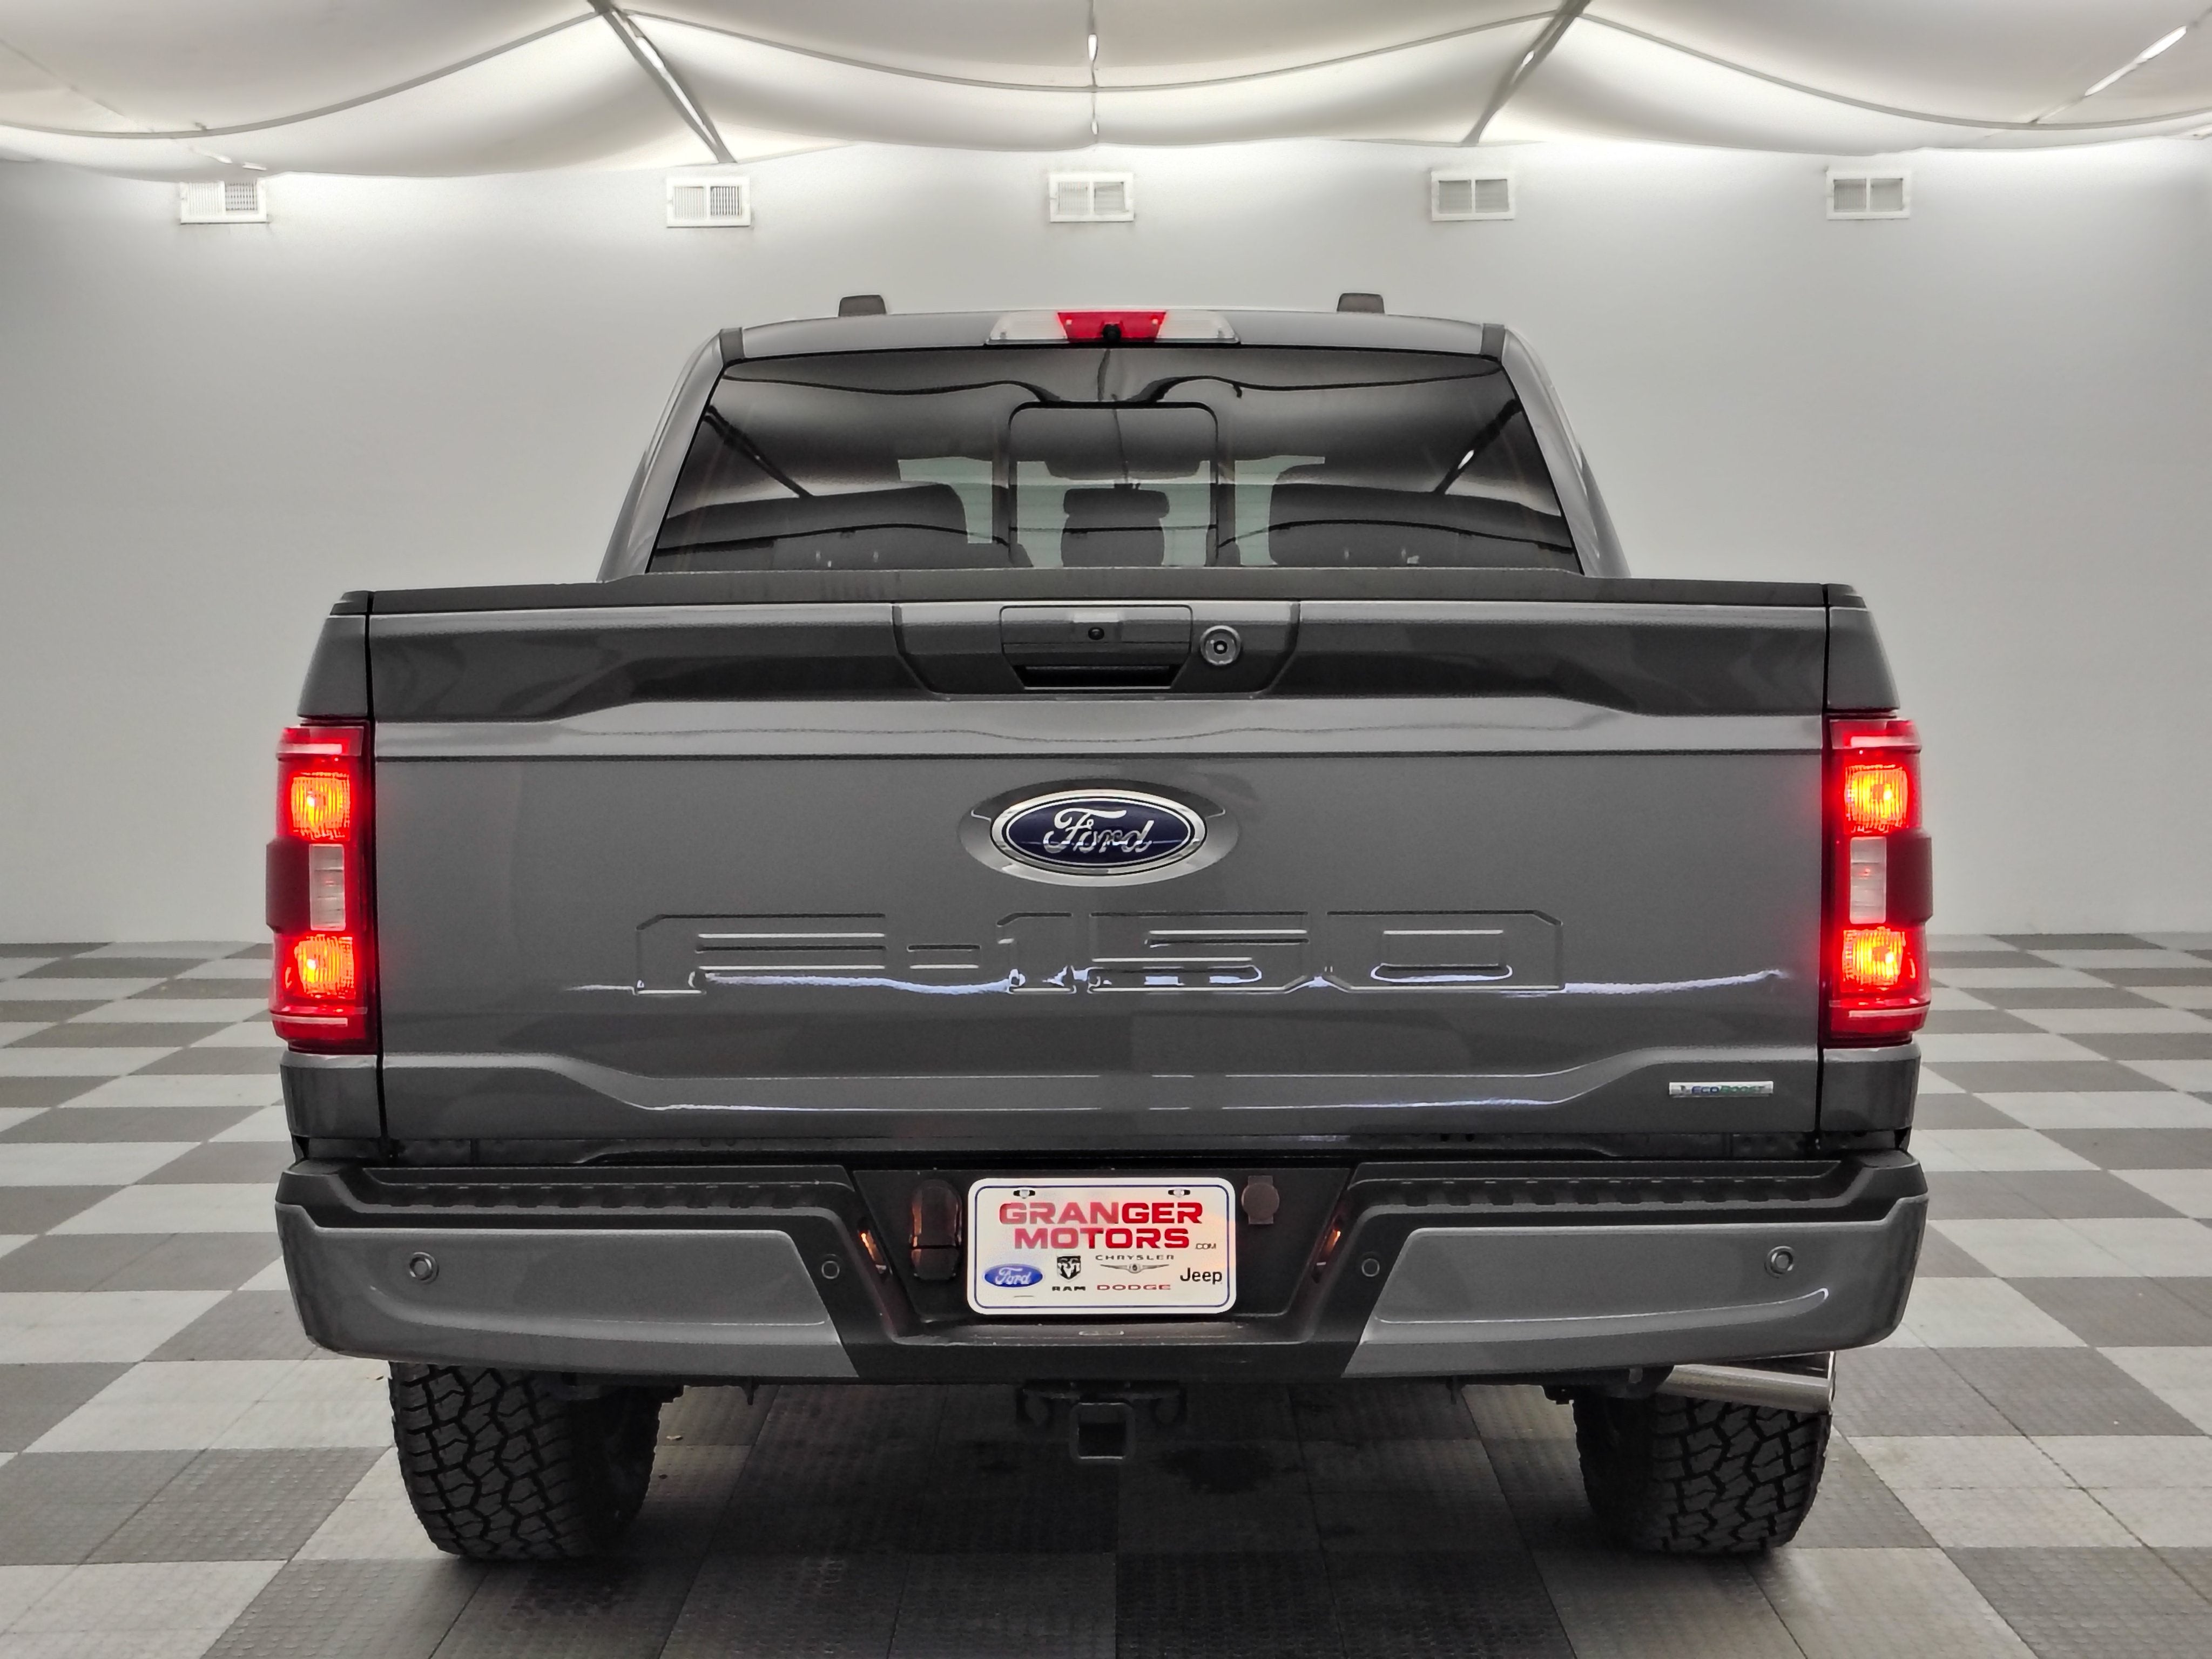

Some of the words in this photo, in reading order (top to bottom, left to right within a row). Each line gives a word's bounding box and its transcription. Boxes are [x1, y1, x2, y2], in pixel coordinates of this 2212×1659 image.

[1043, 808, 1155, 853] Ford
[636, 911, 1564, 996] F-150
[999, 1202, 1203, 1224] GRANGER
[1014, 1228, 1189, 1249] MOTORS
[995, 1268, 1031, 1285] Ford
[1180, 1267, 1222, 1284] Jeep
